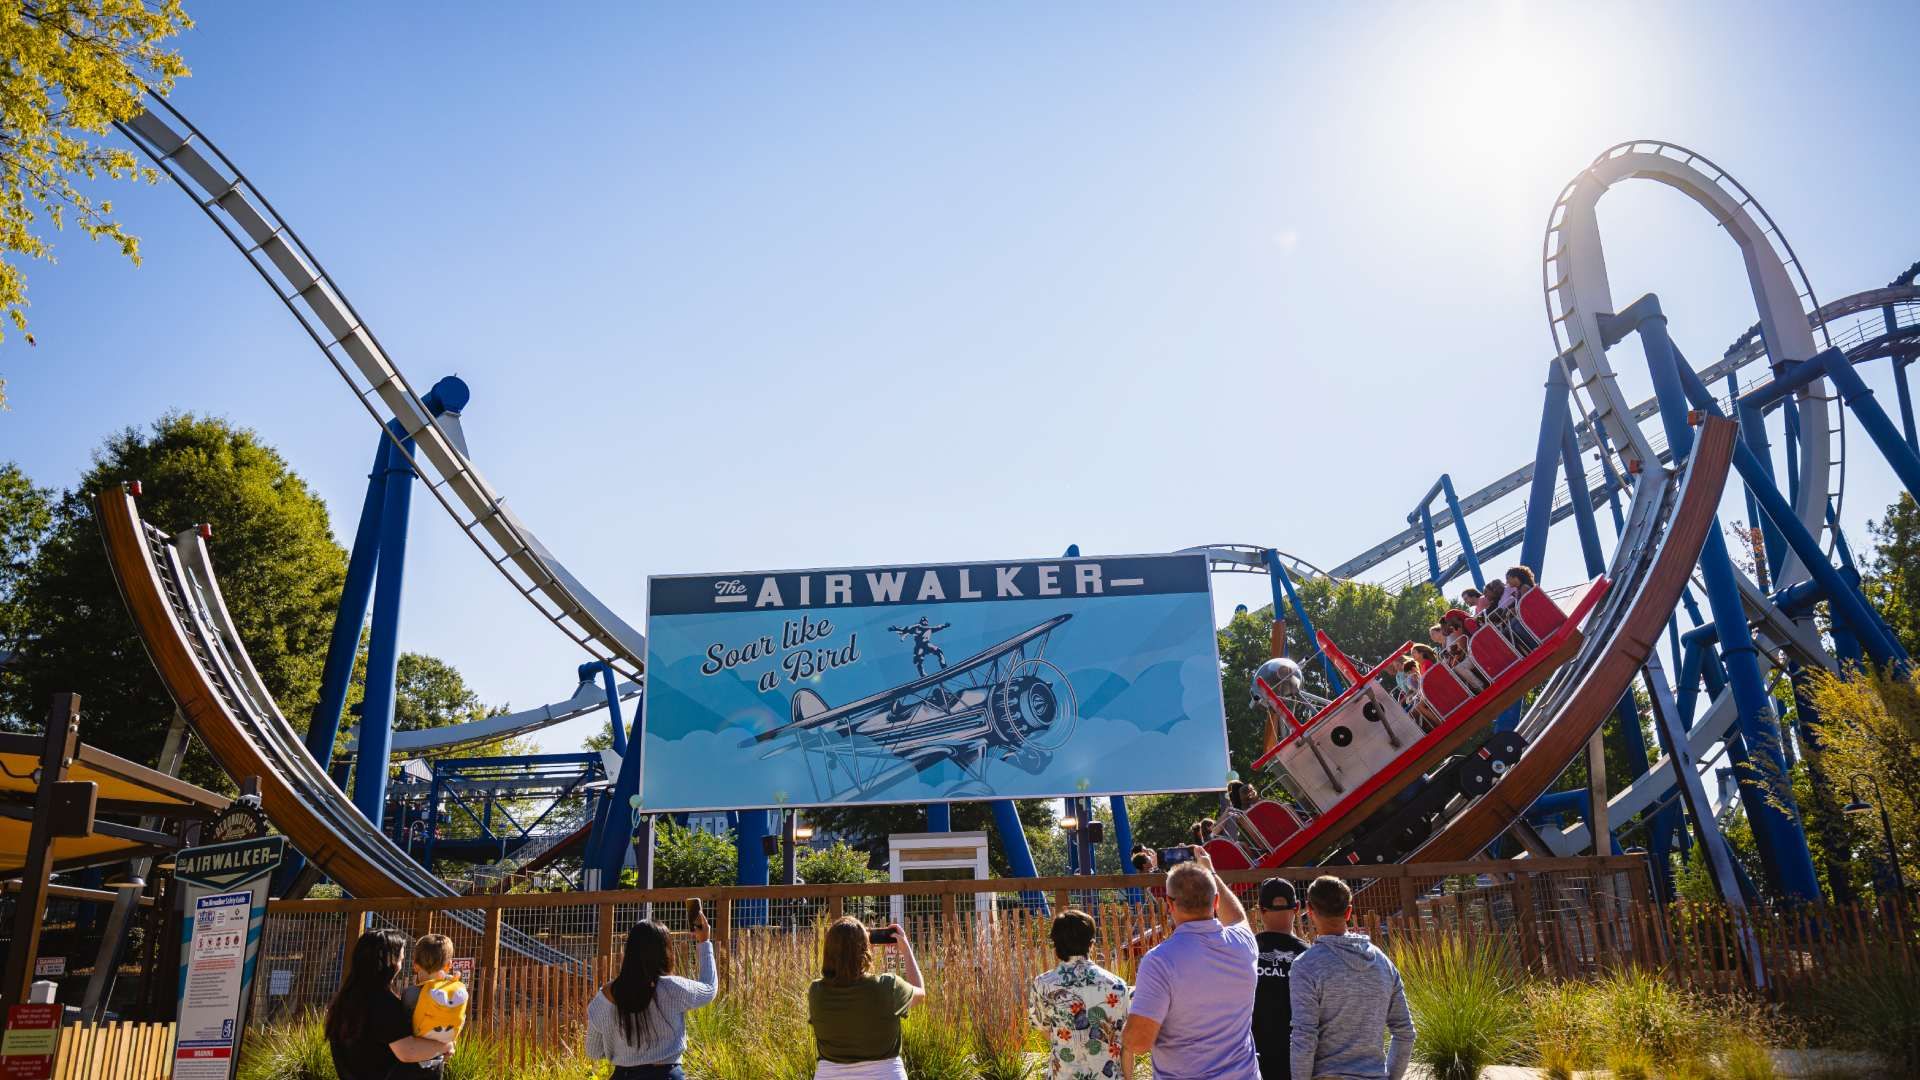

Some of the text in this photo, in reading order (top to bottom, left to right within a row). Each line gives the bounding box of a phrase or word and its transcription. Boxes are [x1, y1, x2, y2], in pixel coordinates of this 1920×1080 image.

[715, 563, 1103, 608] The AIRWALKER
[701, 614, 836, 675] Soar like
[758, 632, 862, 693] a Bird
[186, 847, 270, 873] AIRWALKER
[1257, 966, 1285, 977] OCAL
